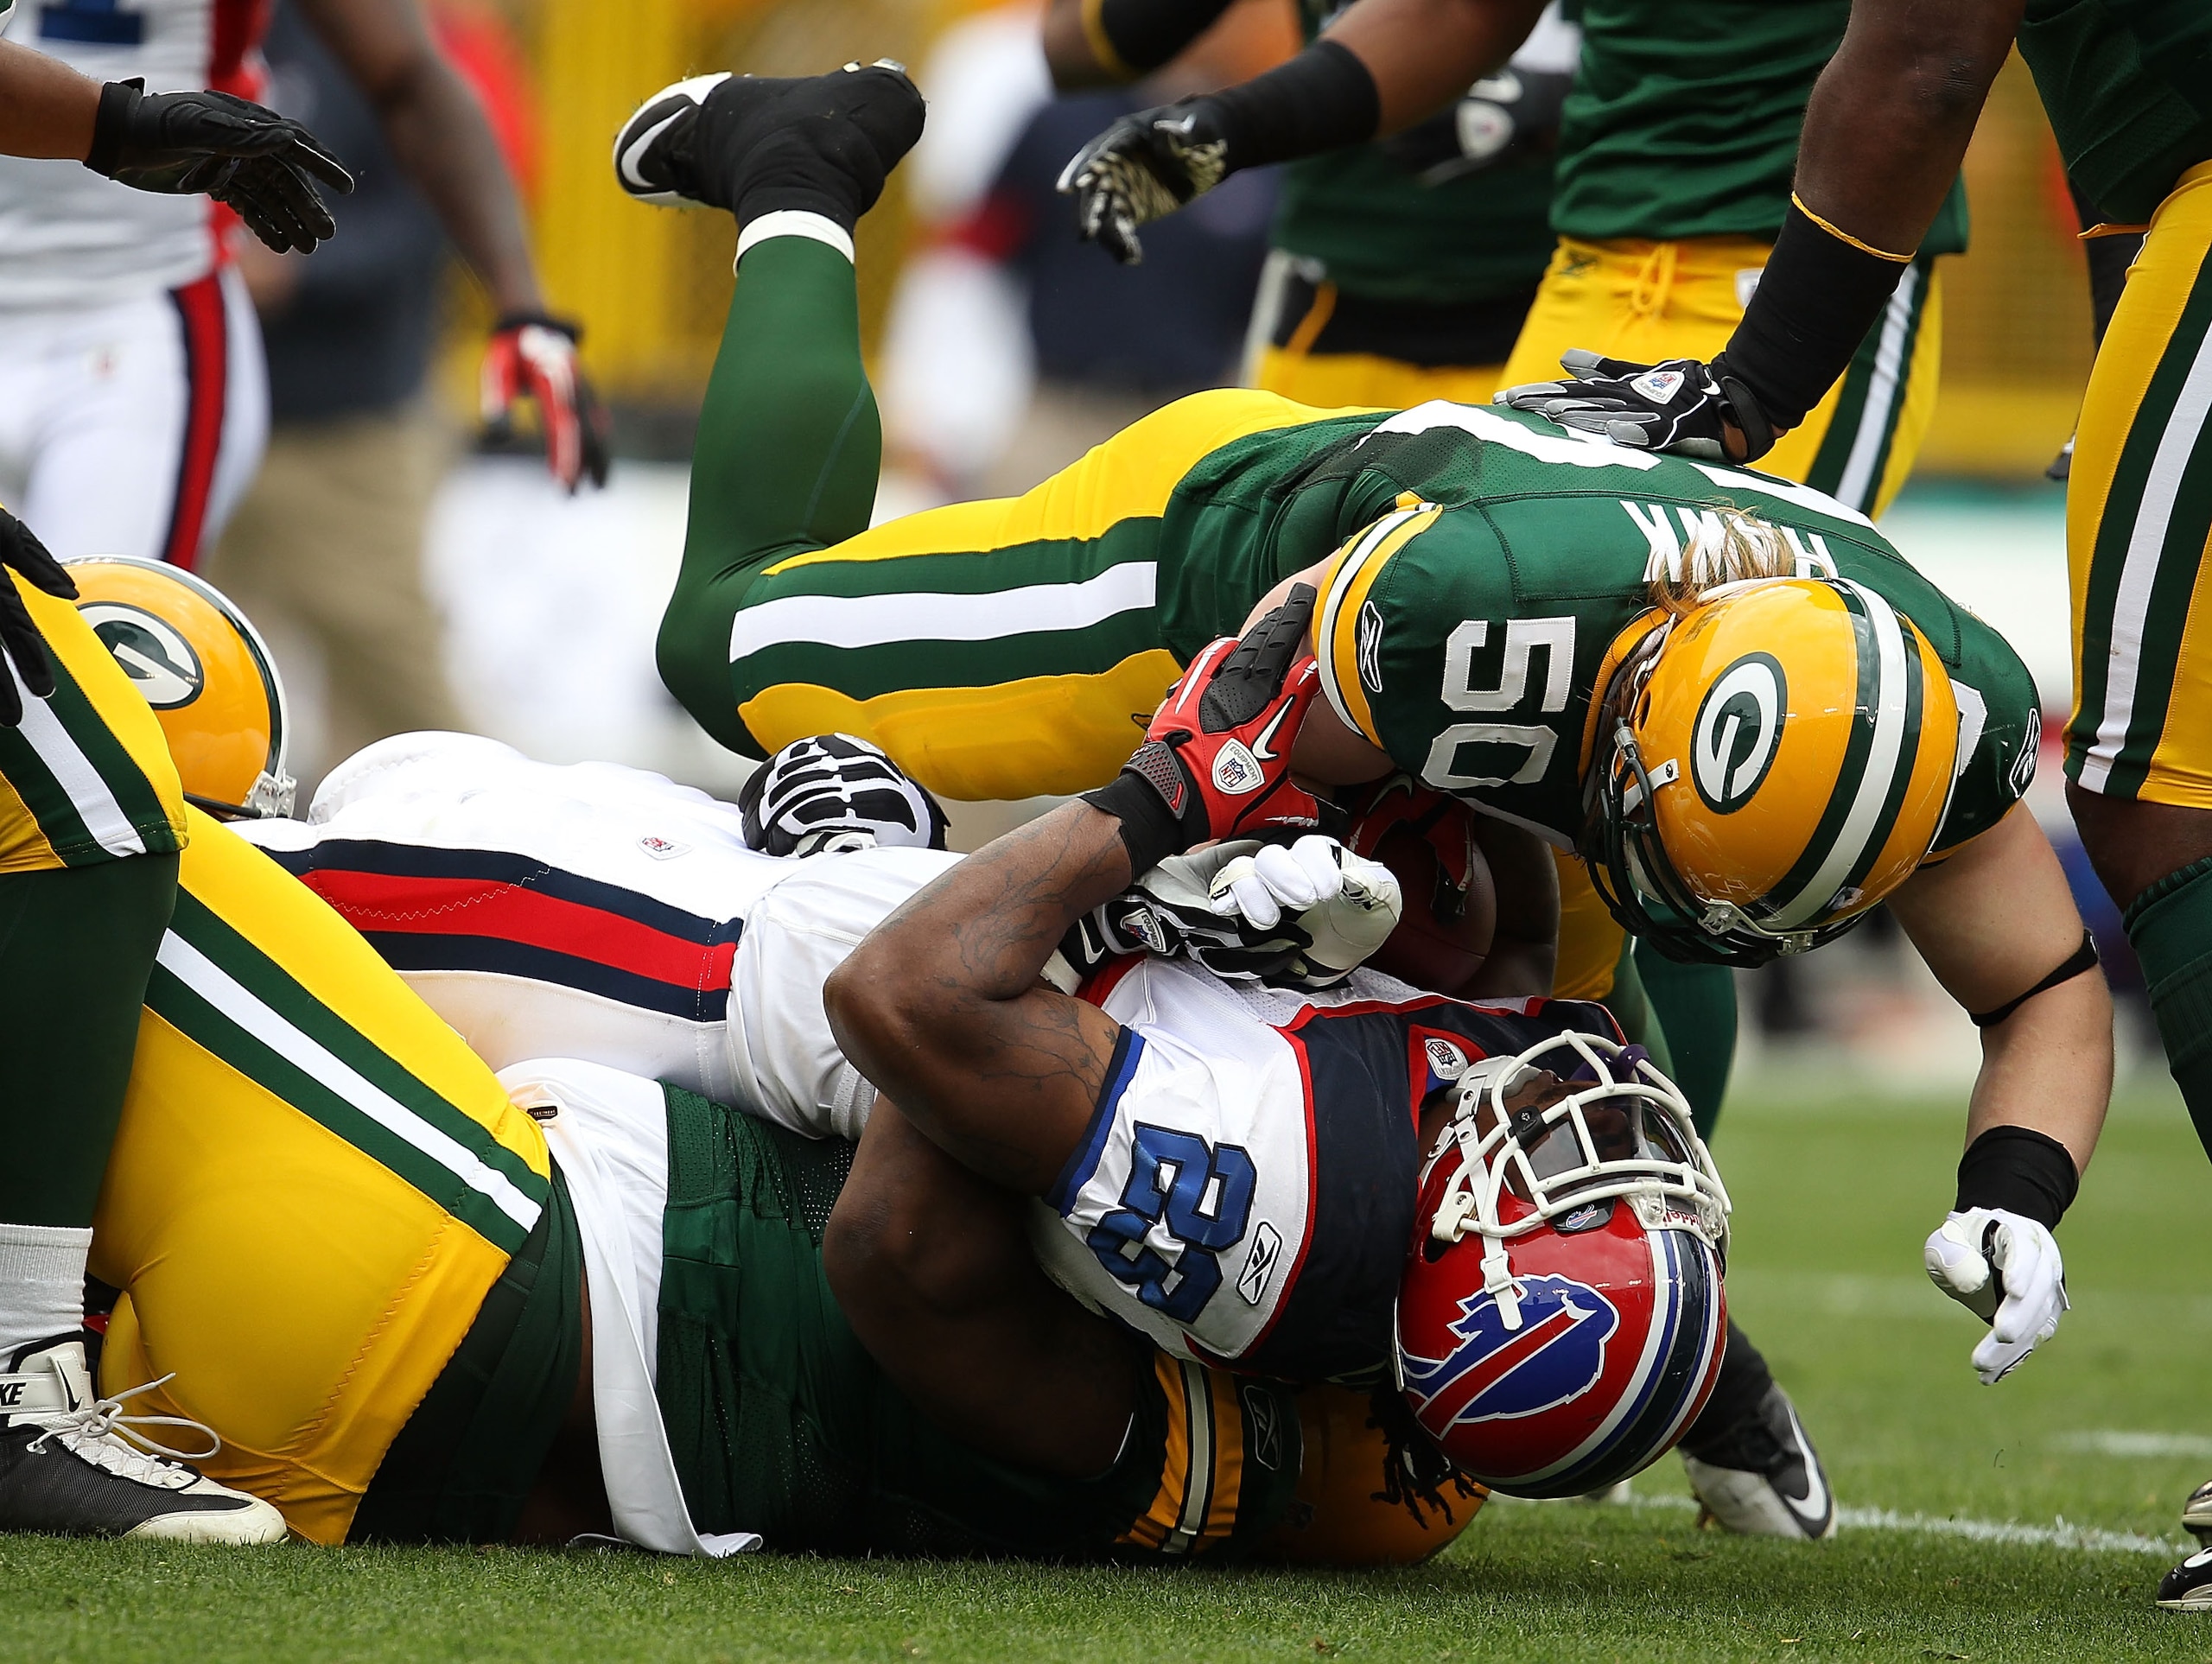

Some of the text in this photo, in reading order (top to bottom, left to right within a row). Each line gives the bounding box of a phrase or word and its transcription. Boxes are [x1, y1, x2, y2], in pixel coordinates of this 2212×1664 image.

[1618, 499, 1840, 583] HAWK
[1421, 616, 1576, 789] 50
[1695, 661, 1779, 803] G
[1220, 765, 1238, 786] NFL
[1230, 745, 1258, 782] EQUIPMENT
[1086, 1120, 1258, 1325] 23
